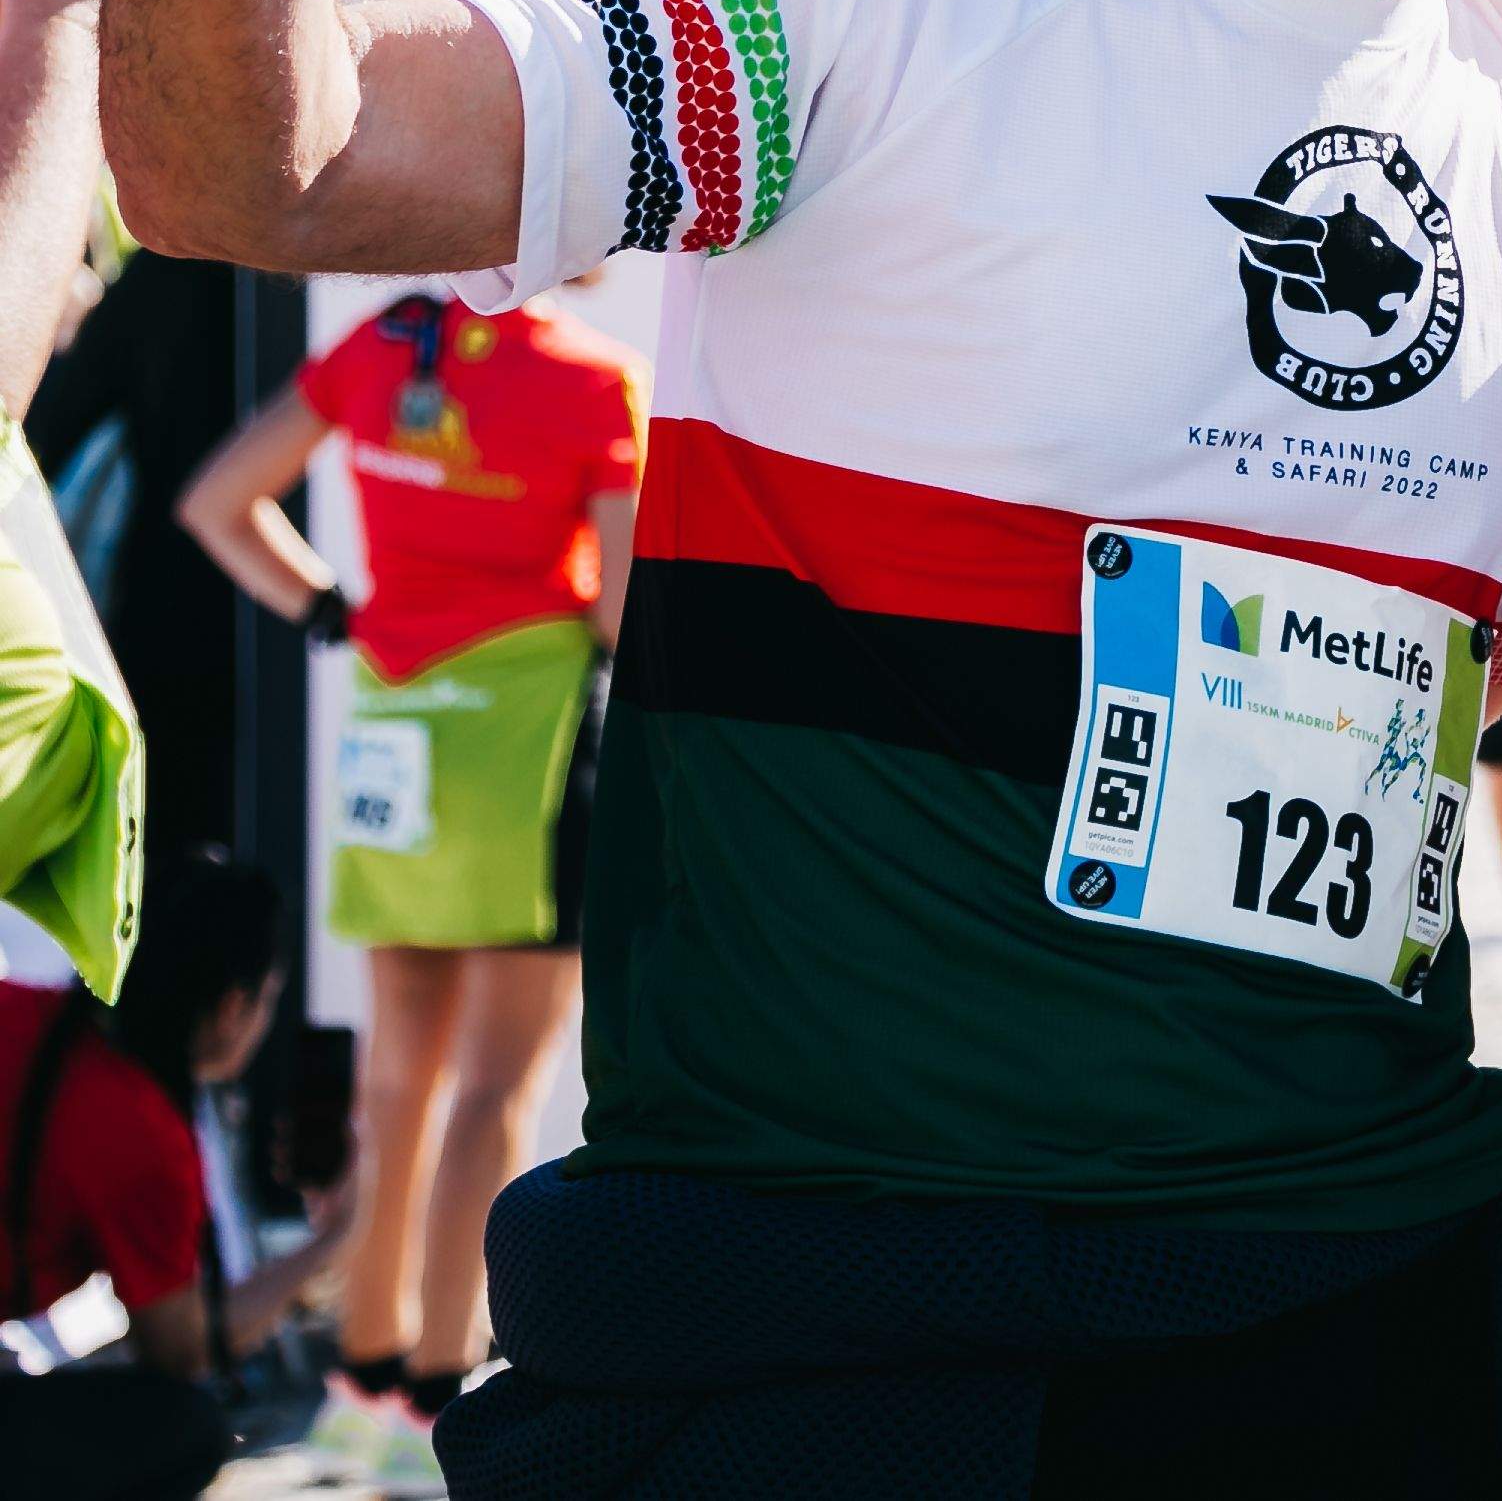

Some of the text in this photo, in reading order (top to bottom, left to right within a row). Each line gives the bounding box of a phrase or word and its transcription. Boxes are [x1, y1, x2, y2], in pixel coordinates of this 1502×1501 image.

[1275, 133, 1460, 402] TIGERS RUNNING CLUB
[1188, 426, 1489, 482] KENYA TRAINING CAMP
[1235, 458, 1439, 500] & SAFARI 2022
[1280, 610, 1433, 693] MetLife
[1201, 672, 1242, 709] VIII
[1247, 701, 1280, 719] 15KM
[1284, 711, 1334, 732] MADRID
[1088, 831, 1134, 845] getpica.com
[1226, 789, 1374, 940] 123
